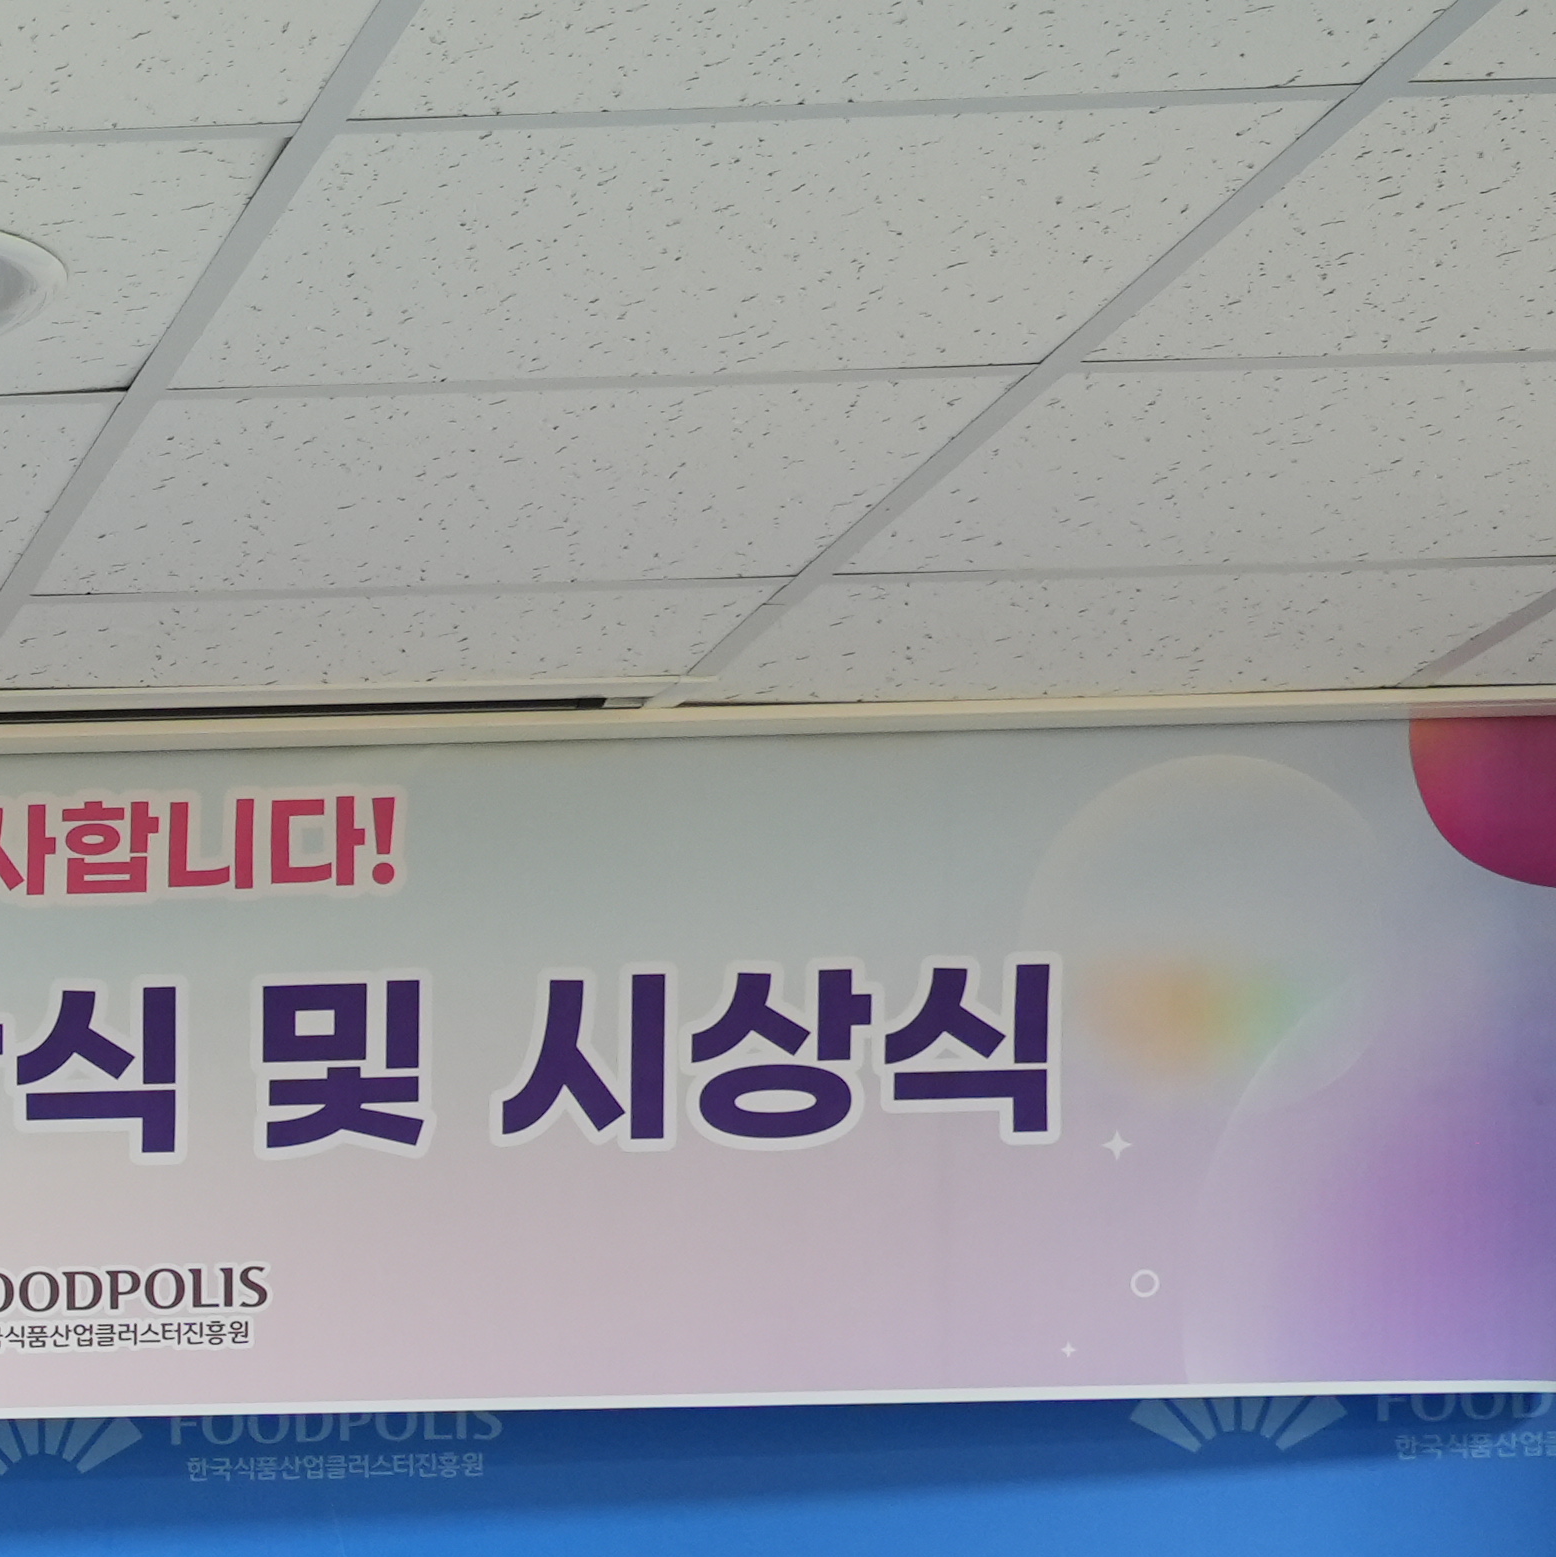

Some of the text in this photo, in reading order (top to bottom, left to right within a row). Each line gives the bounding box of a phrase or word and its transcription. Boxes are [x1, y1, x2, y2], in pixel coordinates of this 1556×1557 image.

[263, 980, 424, 1148] 및
[503, 964, 1050, 1139] 시상식
[170, 1411, 502, 1445] FOODPOLIS
[187, 1452, 483, 1482] 한국식품산업클러스터진흥원
